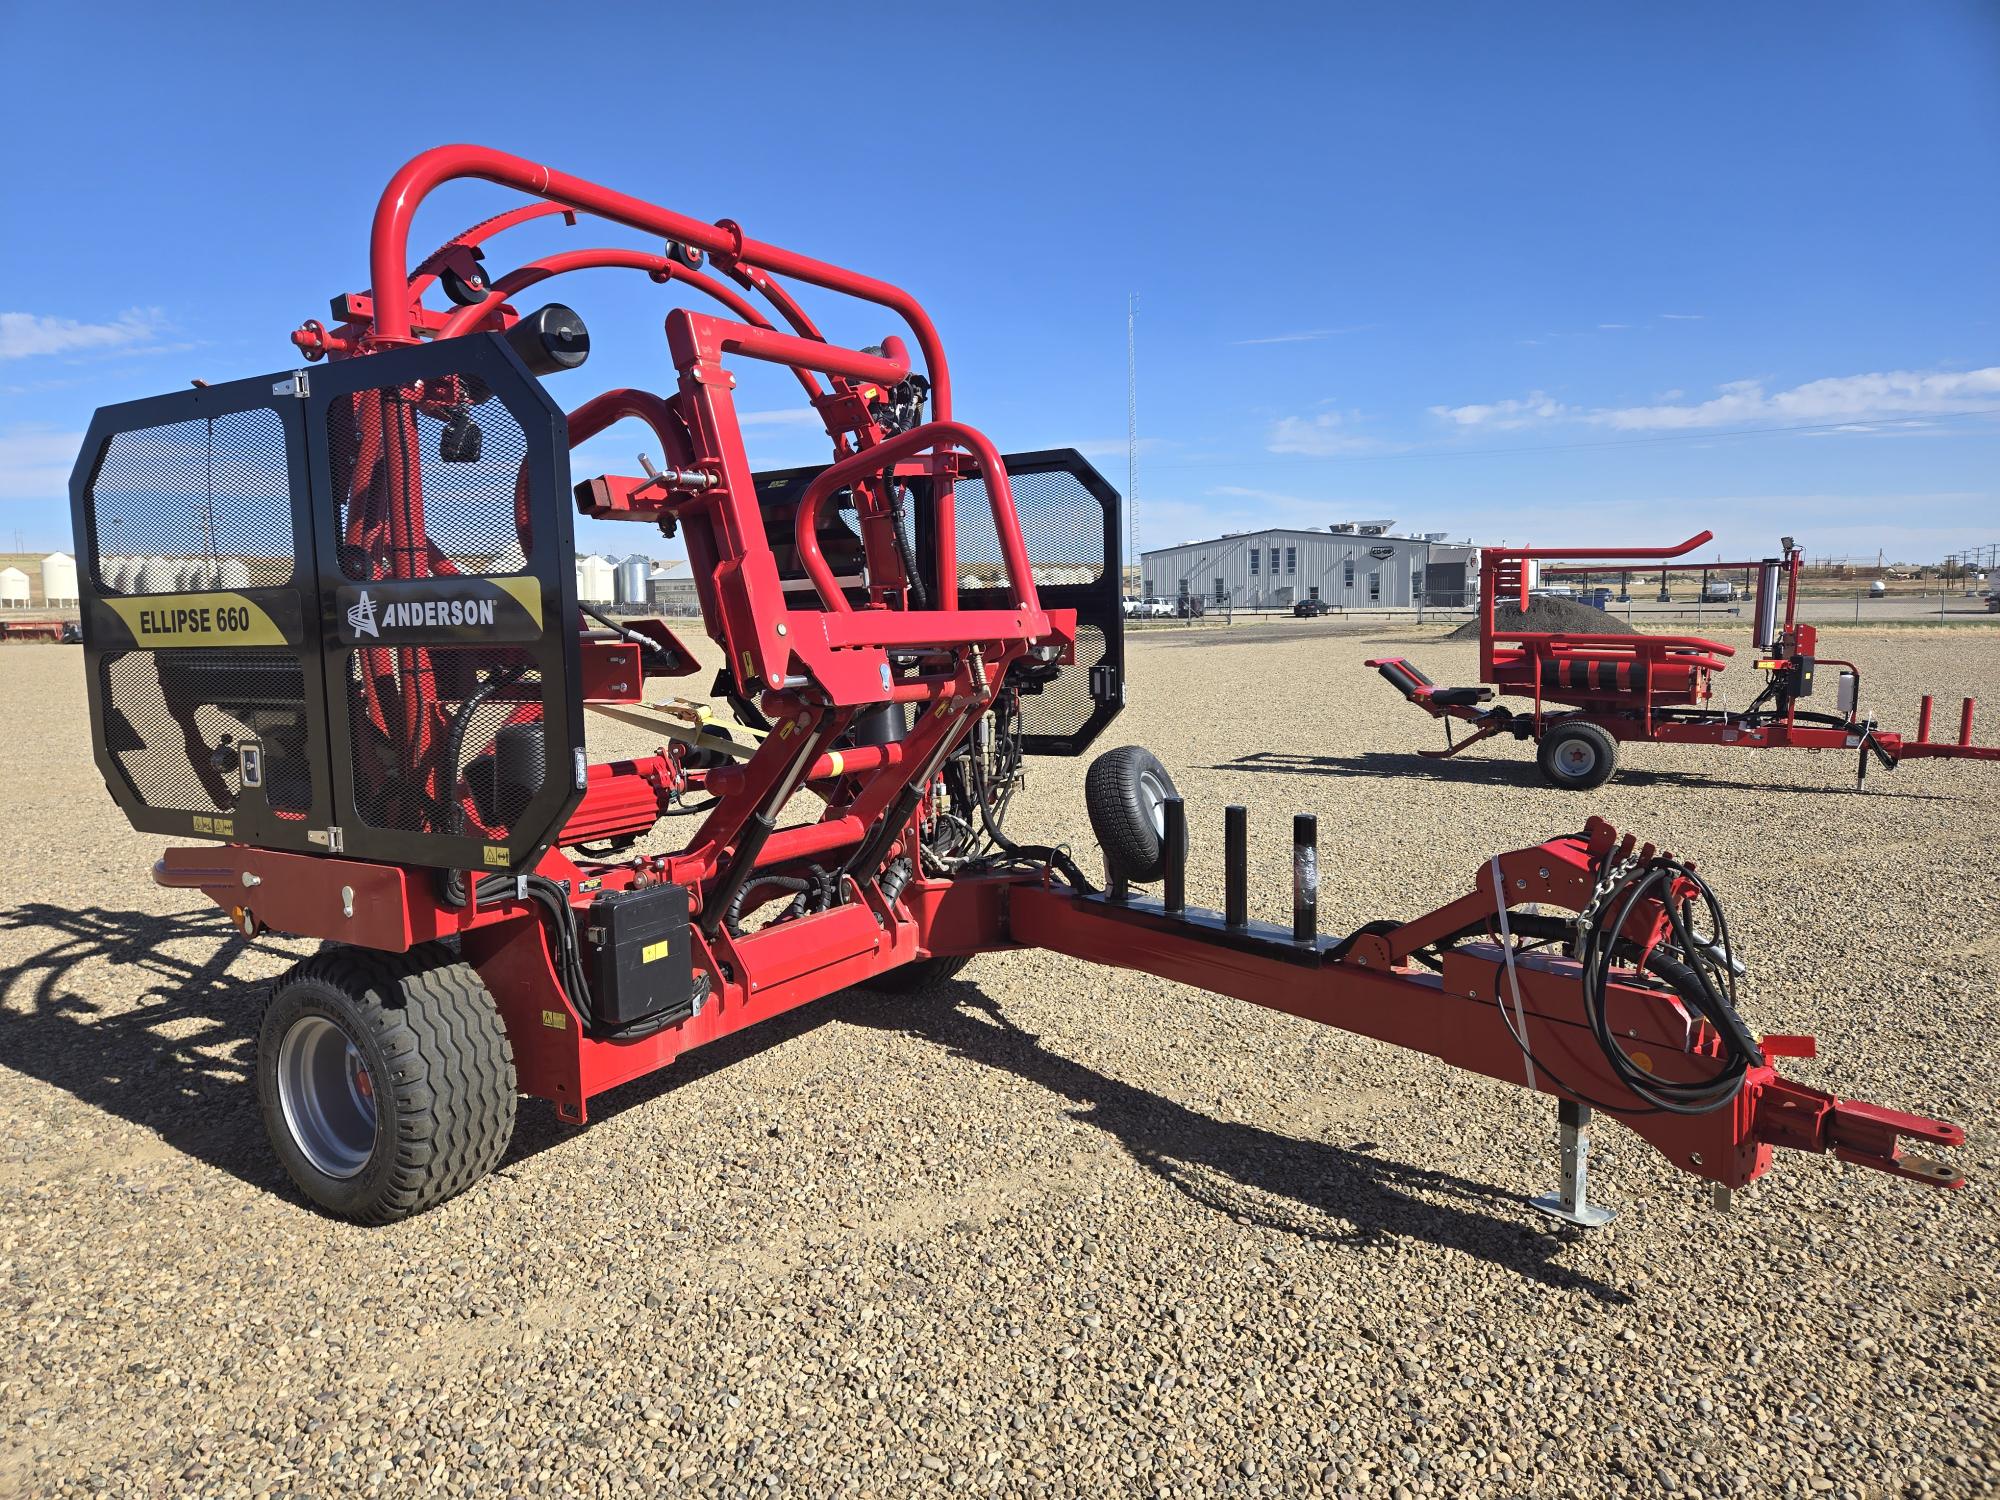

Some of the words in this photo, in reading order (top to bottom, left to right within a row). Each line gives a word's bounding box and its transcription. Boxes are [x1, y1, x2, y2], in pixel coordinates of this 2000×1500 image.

[140, 608, 211, 634] ELLIPSE
[216, 606, 250, 632] 660
[381, 600, 494, 627] ANDERSON
